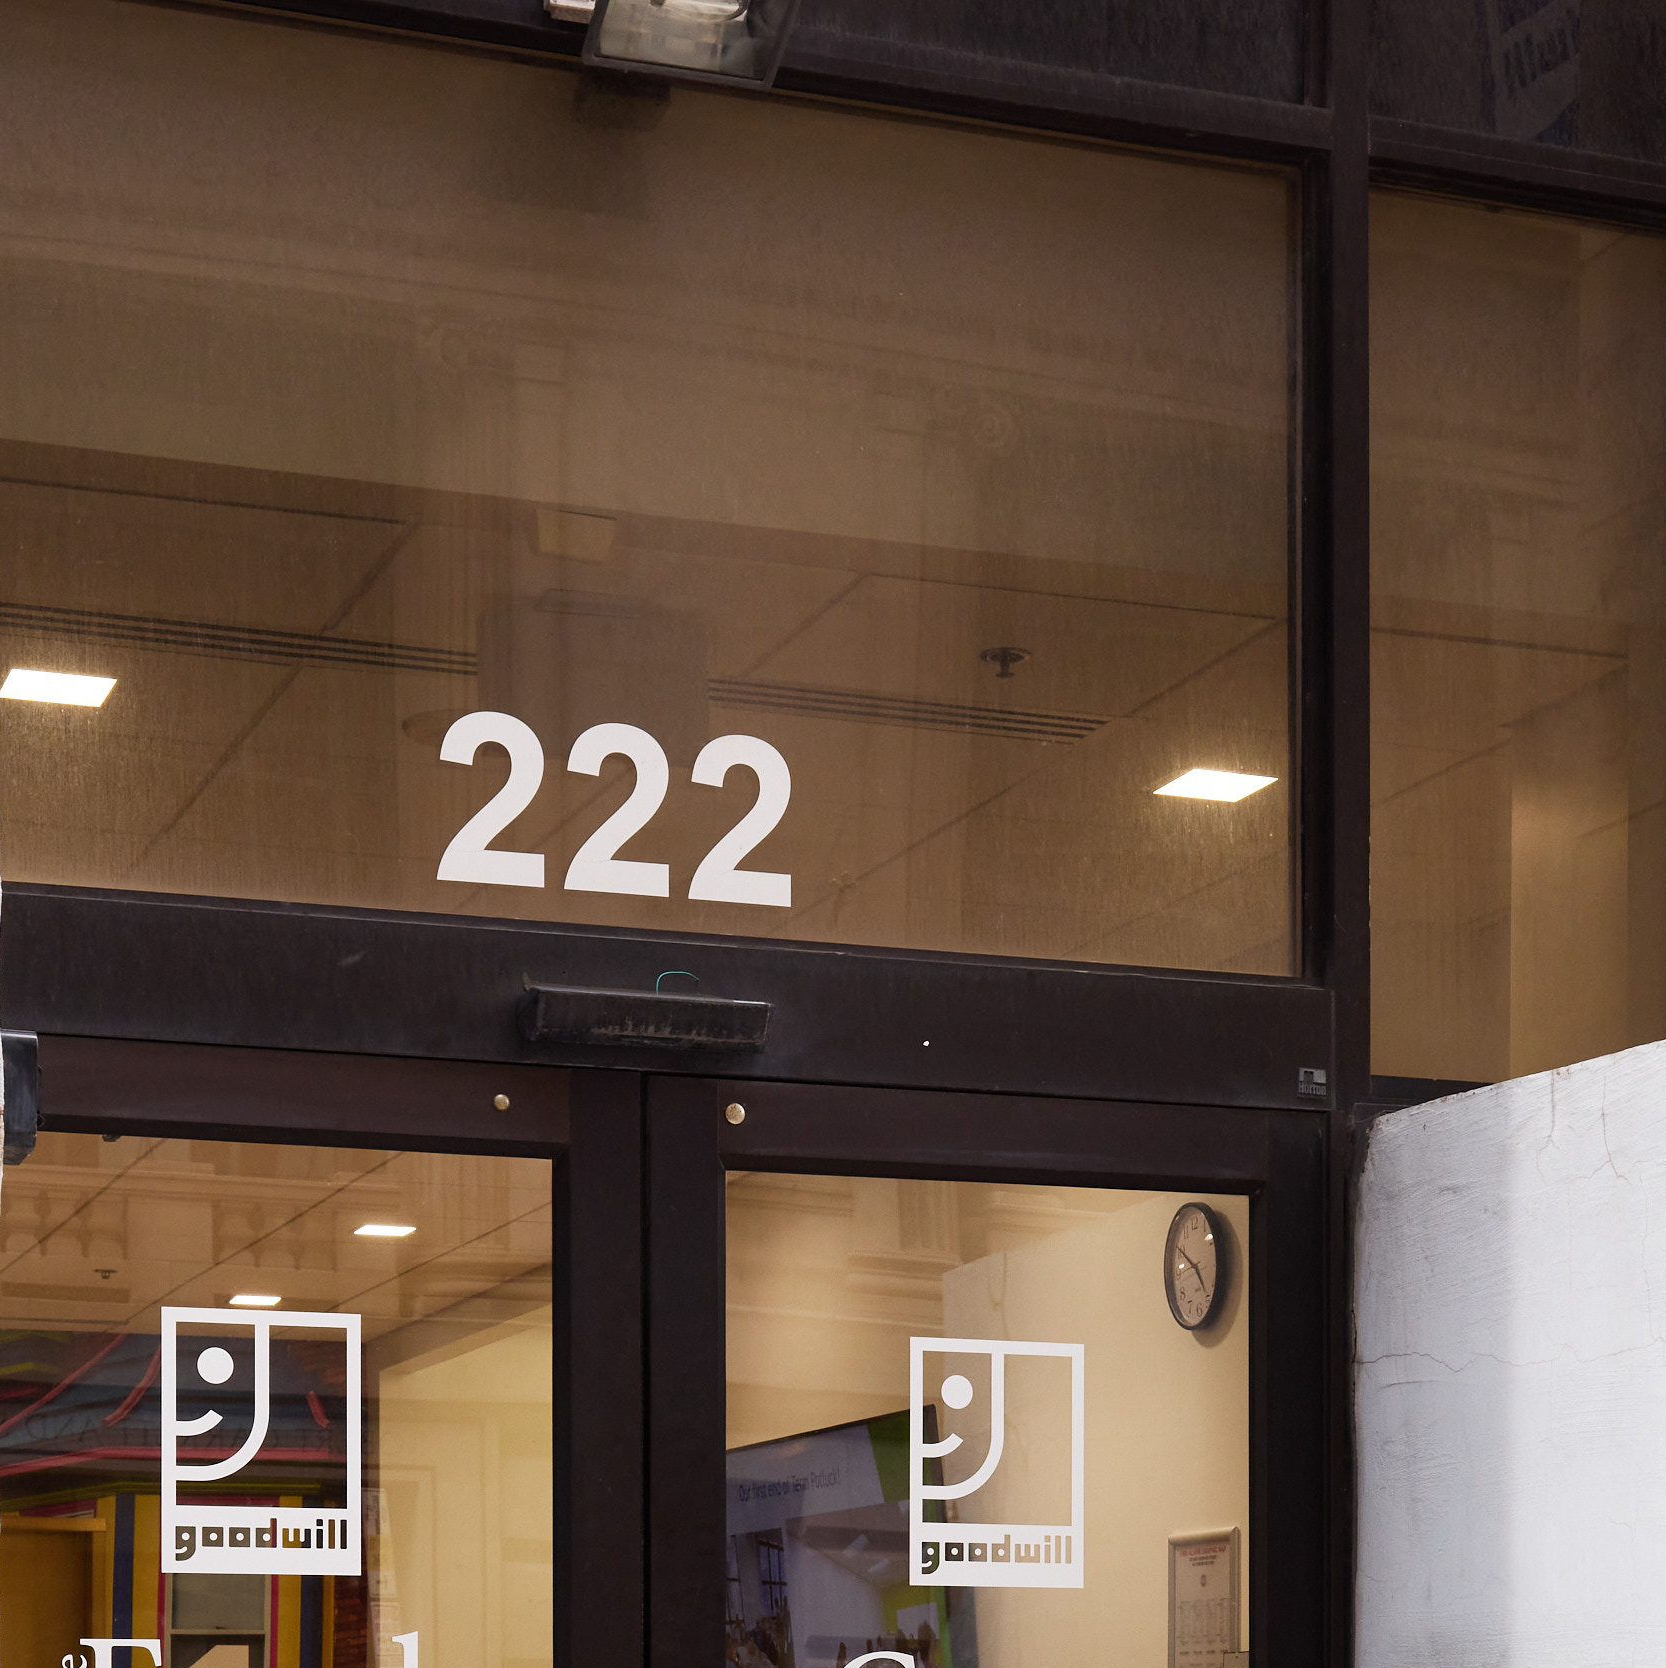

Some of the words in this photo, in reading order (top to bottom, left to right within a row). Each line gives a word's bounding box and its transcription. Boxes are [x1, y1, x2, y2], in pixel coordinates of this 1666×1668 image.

[437, 711, 791, 907] 222
[1299, 1081, 1327, 1095] Horton
[1191, 1215, 1199, 1231] 12
[1179, 1286, 1186, 1300] 8
[1196, 1303, 1203, 1318] 6
[175, 1517, 348, 1562] goodwill
[921, 1533, 1073, 1575] goodwill
